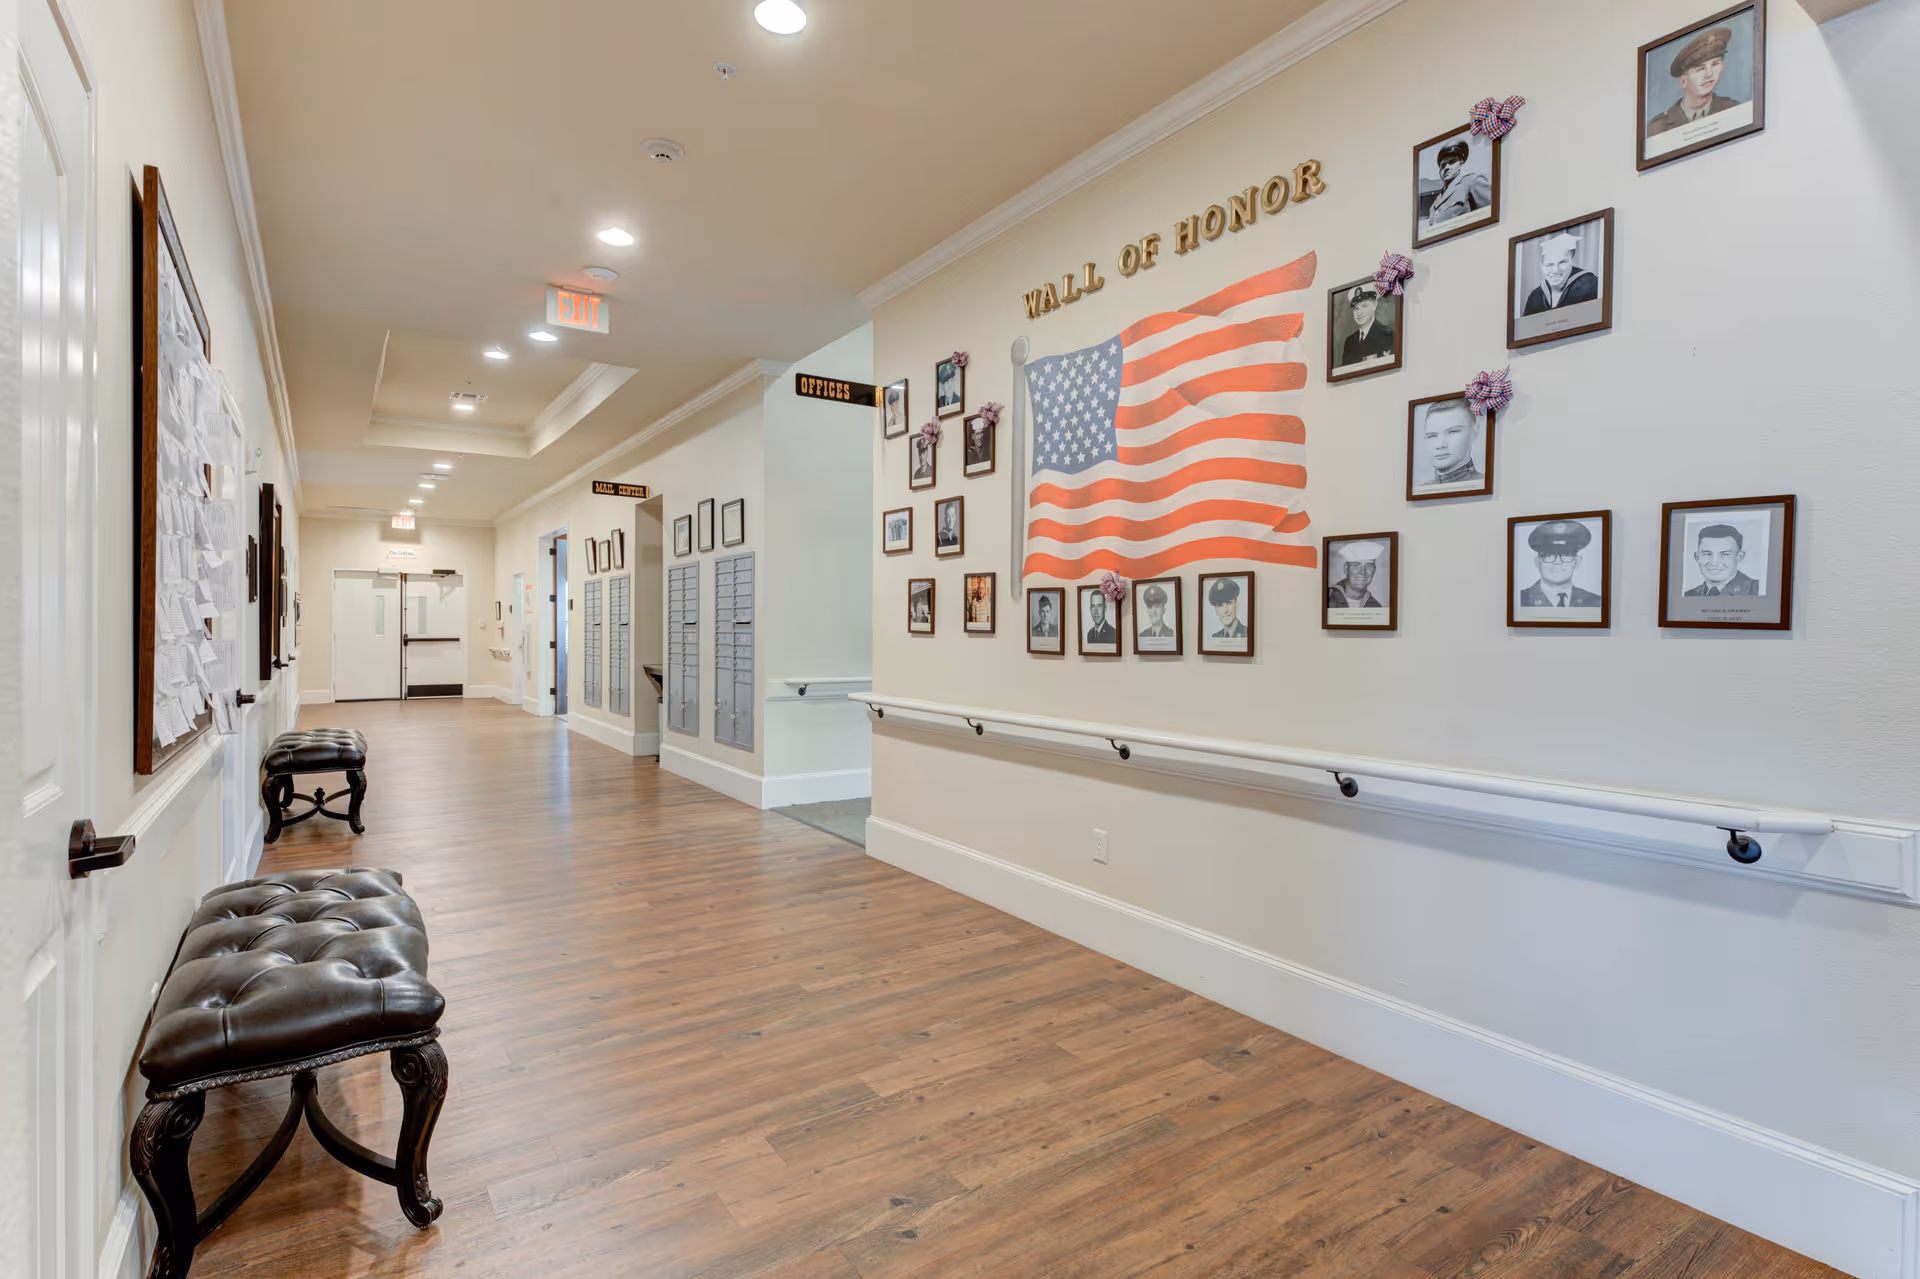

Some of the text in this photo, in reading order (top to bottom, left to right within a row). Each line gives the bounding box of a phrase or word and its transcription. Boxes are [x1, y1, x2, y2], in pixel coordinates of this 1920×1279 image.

[1021, 158, 1327, 319] WALL OF HONOR
[558, 290, 601, 329] EXIT
[800, 376, 850, 401] OFFICES
[595, 482, 645, 497] MAIL CENTER
[395, 515, 412, 528] EXIT
